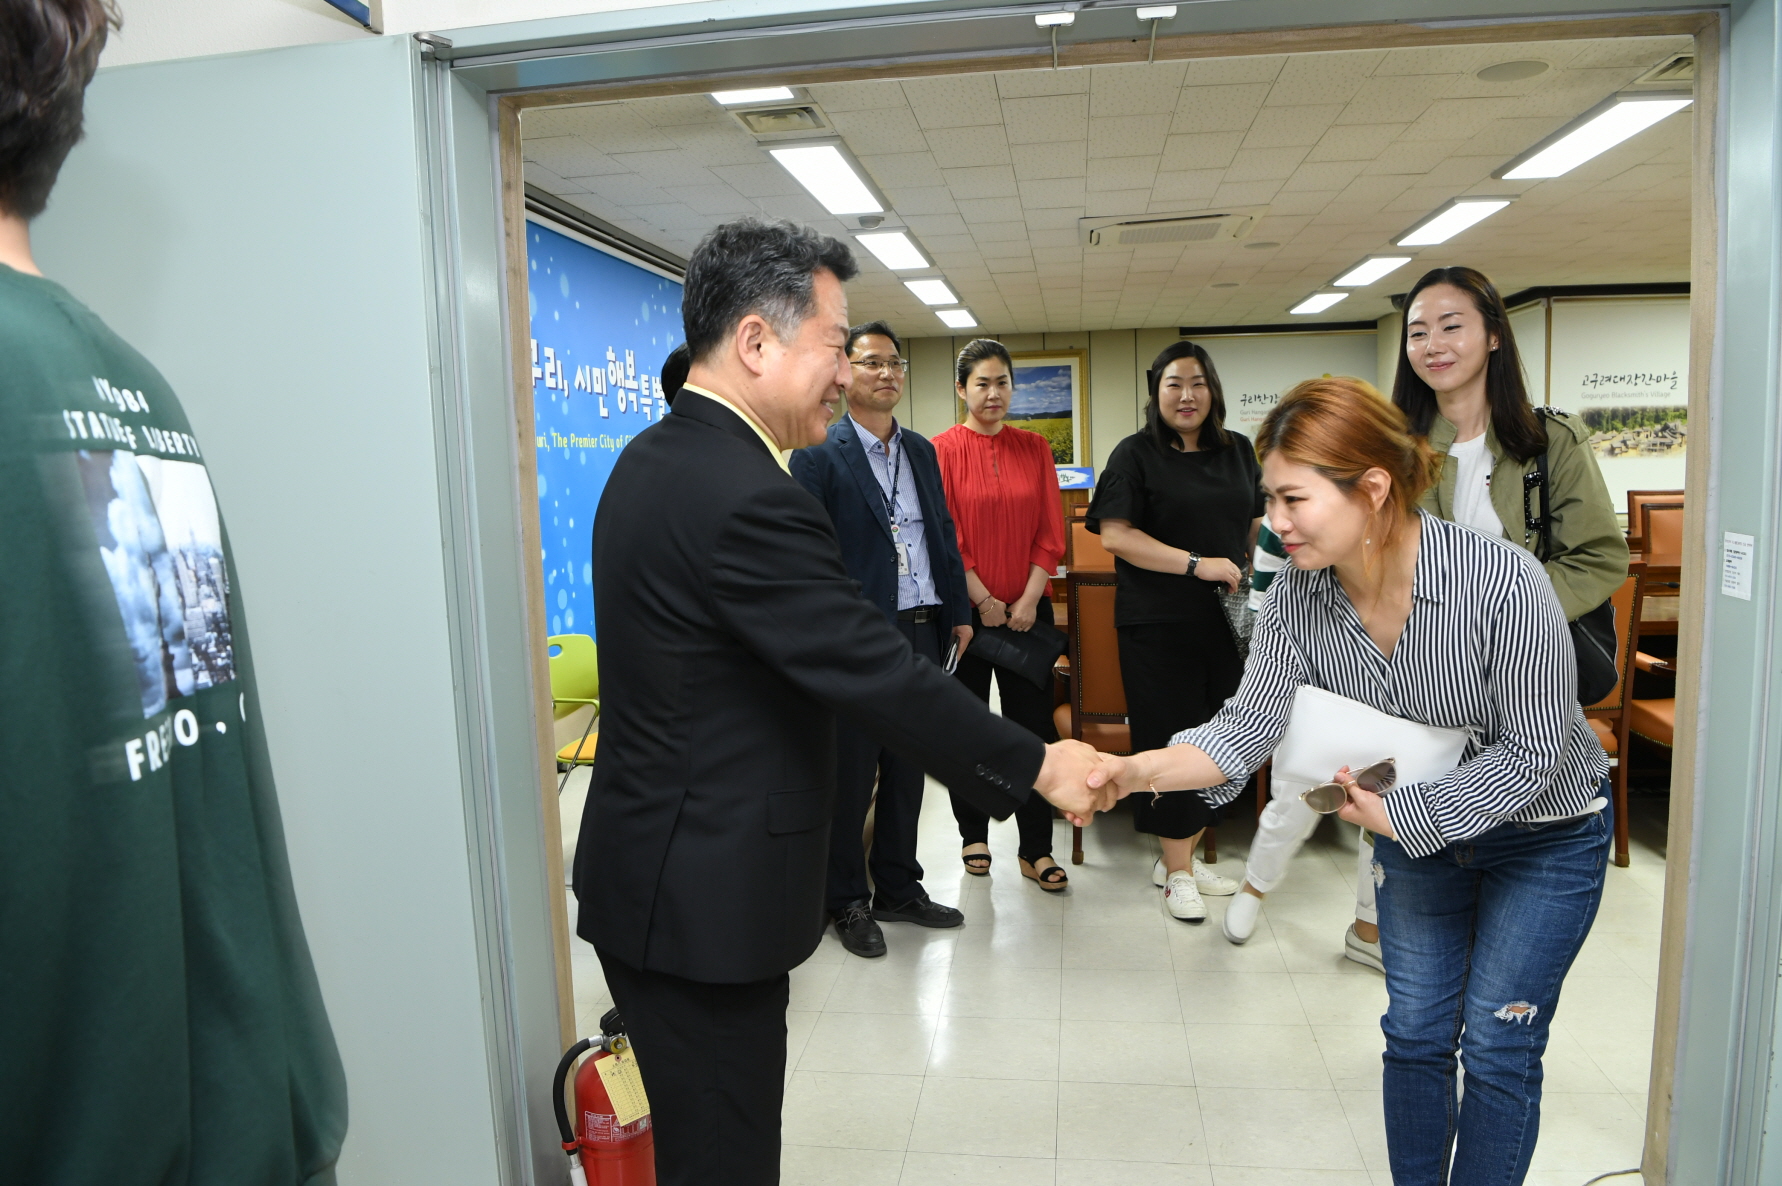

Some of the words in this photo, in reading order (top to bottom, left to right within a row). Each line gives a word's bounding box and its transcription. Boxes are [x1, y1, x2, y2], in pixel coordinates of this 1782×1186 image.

[1582, 370, 1678, 390] 고구려대장간마을
[1581, 391, 1610, 400] Goguryeo
[1611, 391, 1649, 399] Blacksmith's
[1651, 391, 1671, 400] Village
[536, 432, 550, 452] uri,
[552, 432, 568, 448] The
[570, 432, 598, 449] Premier
[600, 433, 615, 453] City
[616, 434, 623, 448] of
